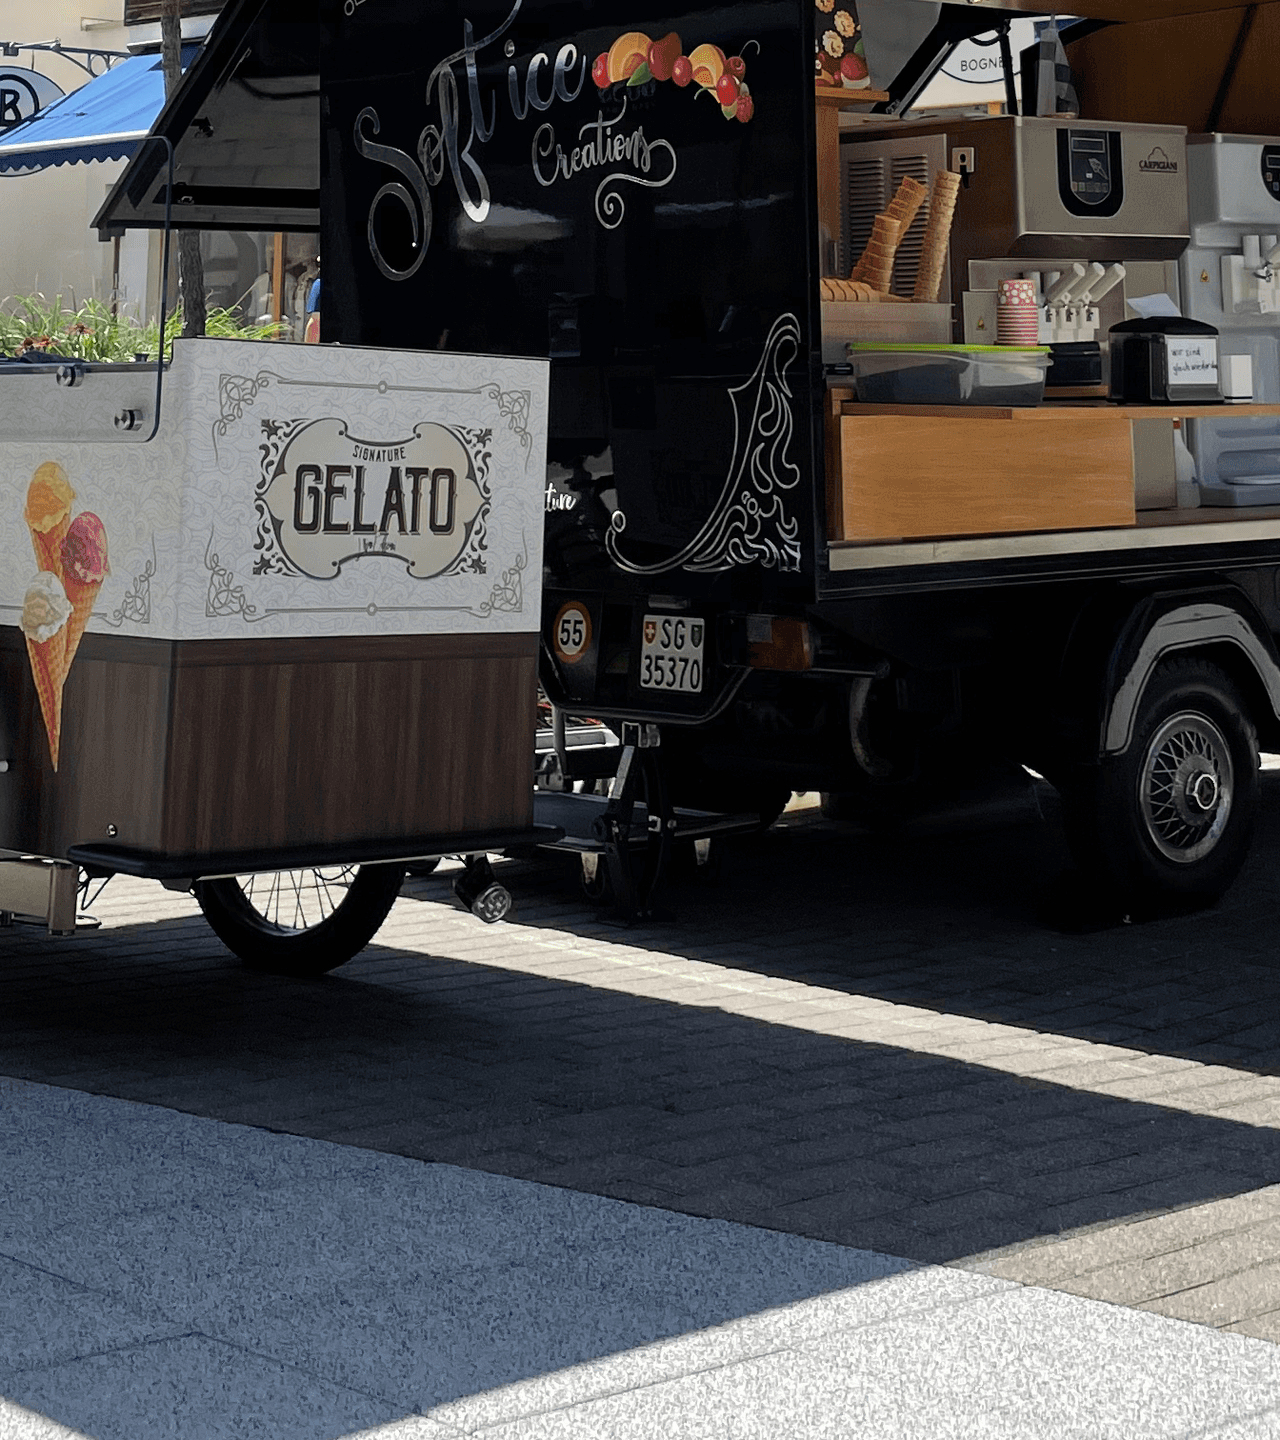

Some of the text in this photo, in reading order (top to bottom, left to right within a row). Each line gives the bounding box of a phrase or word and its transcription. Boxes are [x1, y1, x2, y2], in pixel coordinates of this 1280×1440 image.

[504, 39, 587, 121] ice
[960, 56, 1005, 72] BOGNE
[531, 95, 677, 229] Creations
[352, 444, 407, 463] SIGNATURE
[293, 464, 458, 536] GELATO
[559, 619, 583, 648] 55
[660, 618, 686, 651] SG
[641, 654, 702, 690] 35370
